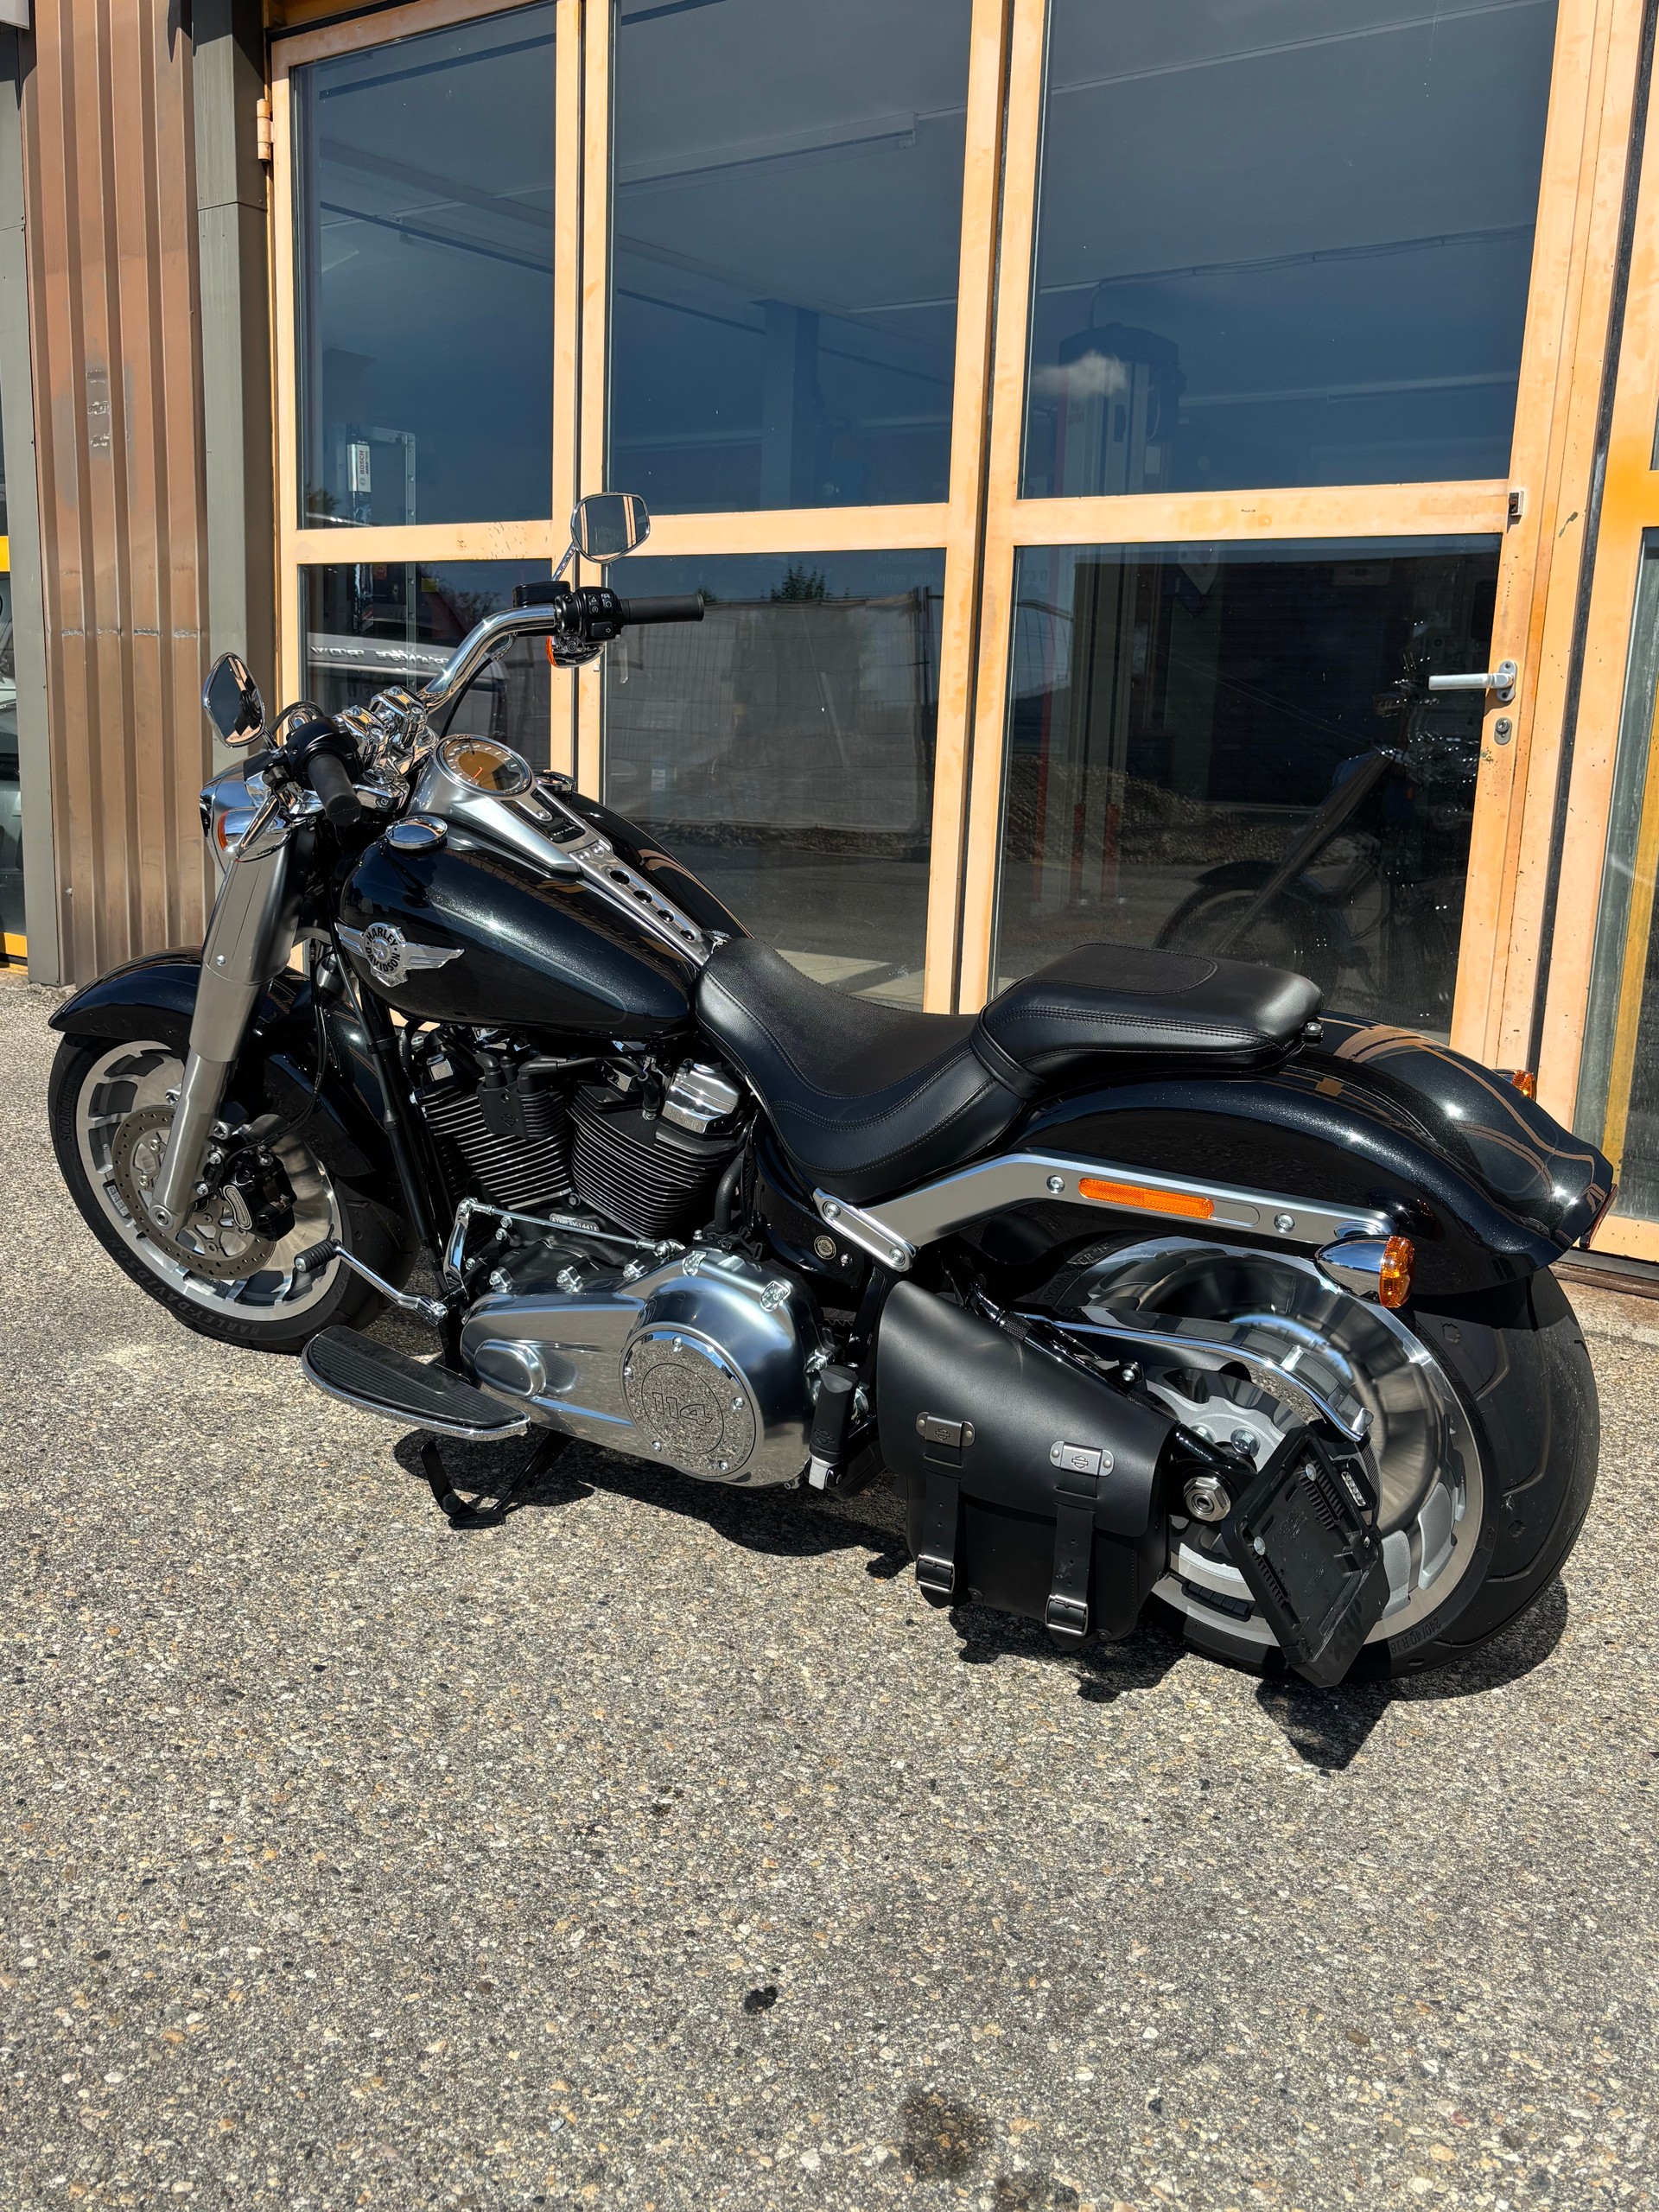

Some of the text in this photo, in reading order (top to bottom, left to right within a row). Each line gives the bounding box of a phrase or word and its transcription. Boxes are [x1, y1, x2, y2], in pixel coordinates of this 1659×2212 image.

[366, 926, 399, 949] HARLEY
[365, 946, 401, 974] DAVIDSON
[59, 1080, 77, 1142] SCORCHER
[107, 1238, 261, 1337] HARLEY-DAVIDSON
[652, 1391, 713, 1427] 114
[1409, 1618, 1442, 1645] 240/40
